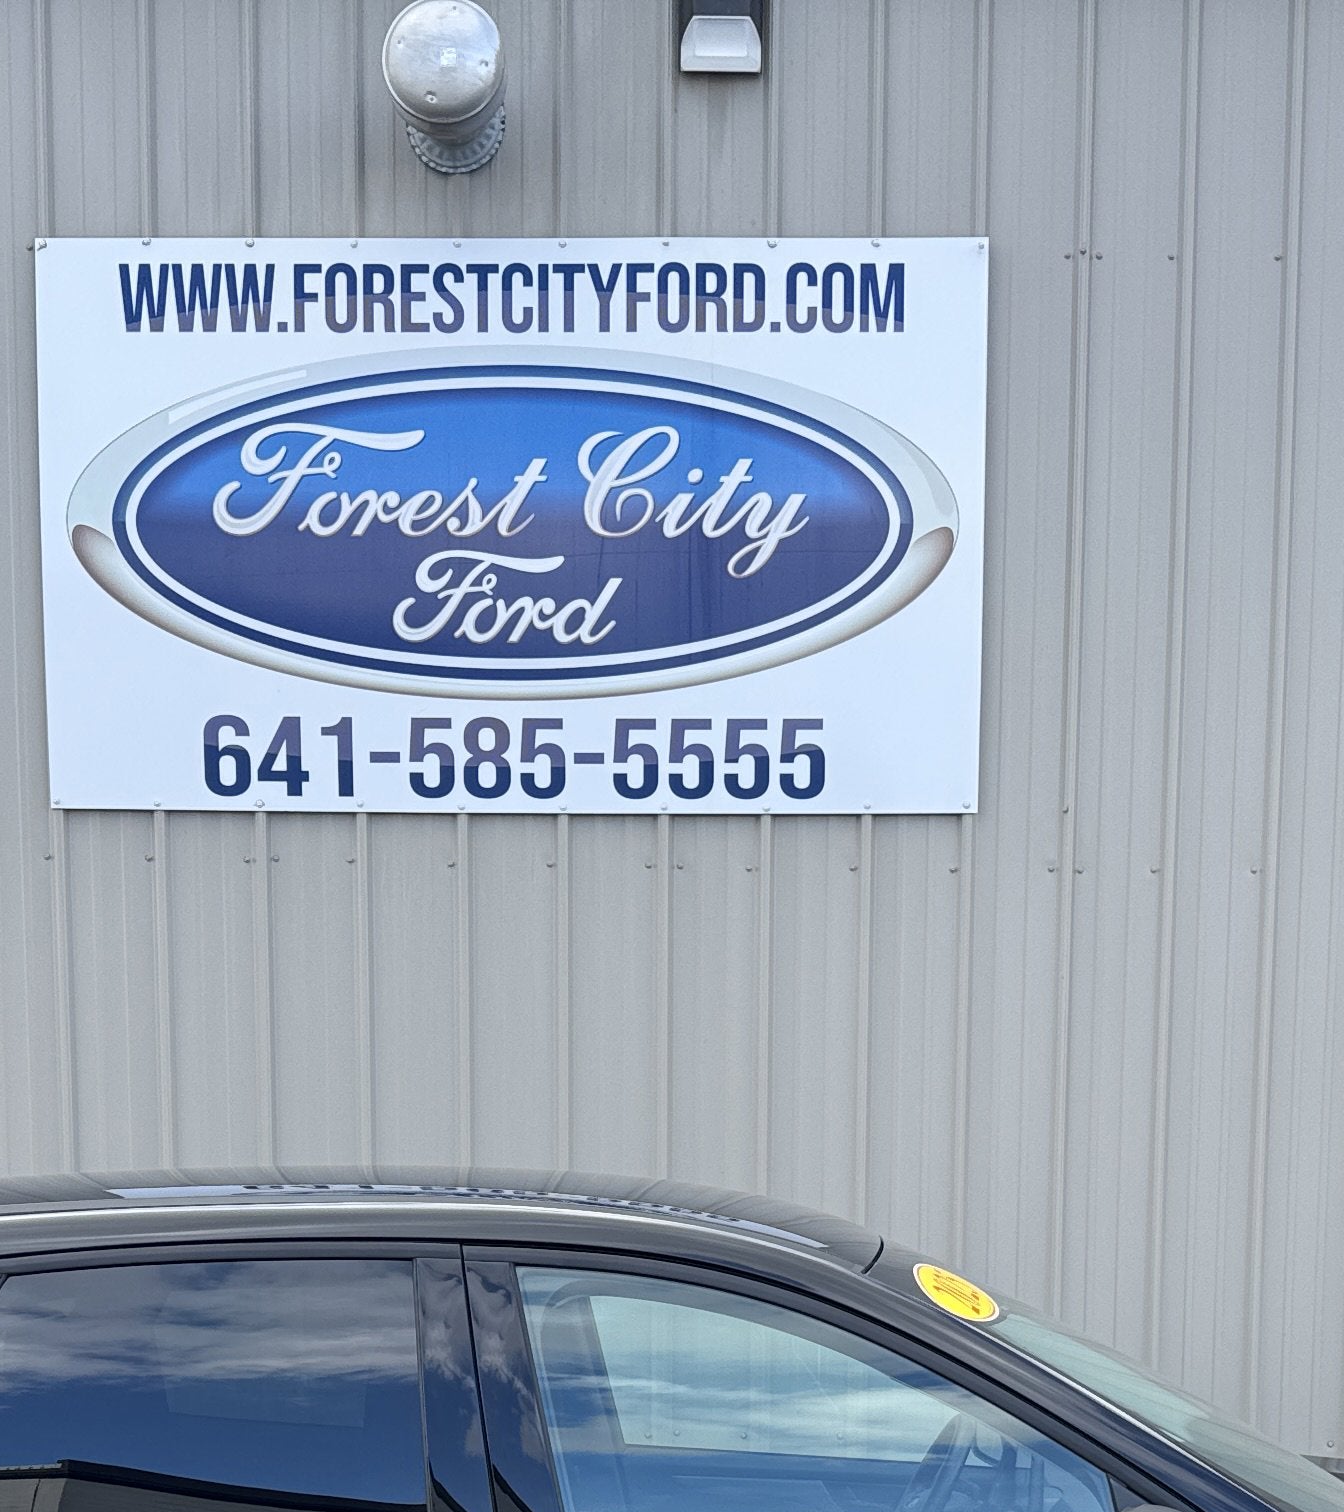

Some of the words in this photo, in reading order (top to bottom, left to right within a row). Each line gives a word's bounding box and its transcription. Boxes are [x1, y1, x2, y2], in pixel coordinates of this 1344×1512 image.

[119, 261, 906, 333] WWW.FORESTCITYFORD.COM
[211, 422, 548, 539] Forest
[575, 425, 810, 578] City
[391, 549, 622, 646] Ford
[202, 715, 827, 801] 641-585-5555
